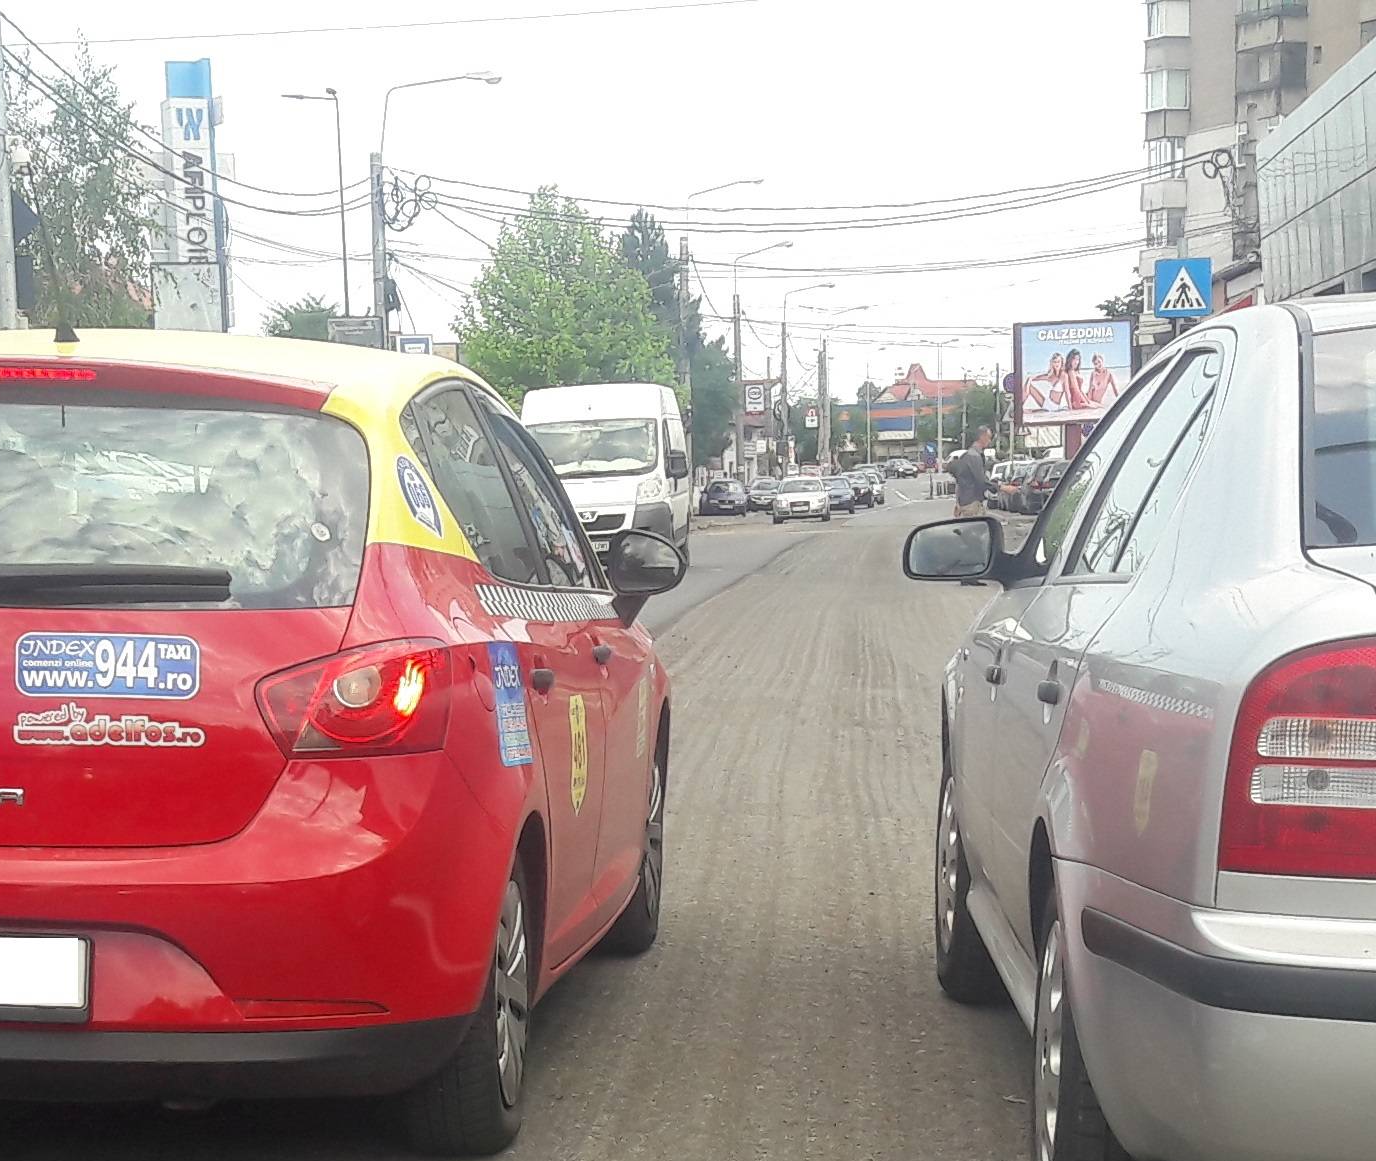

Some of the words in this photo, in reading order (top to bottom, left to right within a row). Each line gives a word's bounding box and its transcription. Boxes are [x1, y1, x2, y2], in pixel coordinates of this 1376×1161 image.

[1038, 326, 1114, 341] CALZEDONIA
[21, 639, 95, 657] INDEX
[157, 643, 191, 660] TAXI
[22, 659, 63, 667] comenzi
[64, 660, 94, 668] online
[20, 706, 68, 727] powered
[71, 704, 86, 722] by
